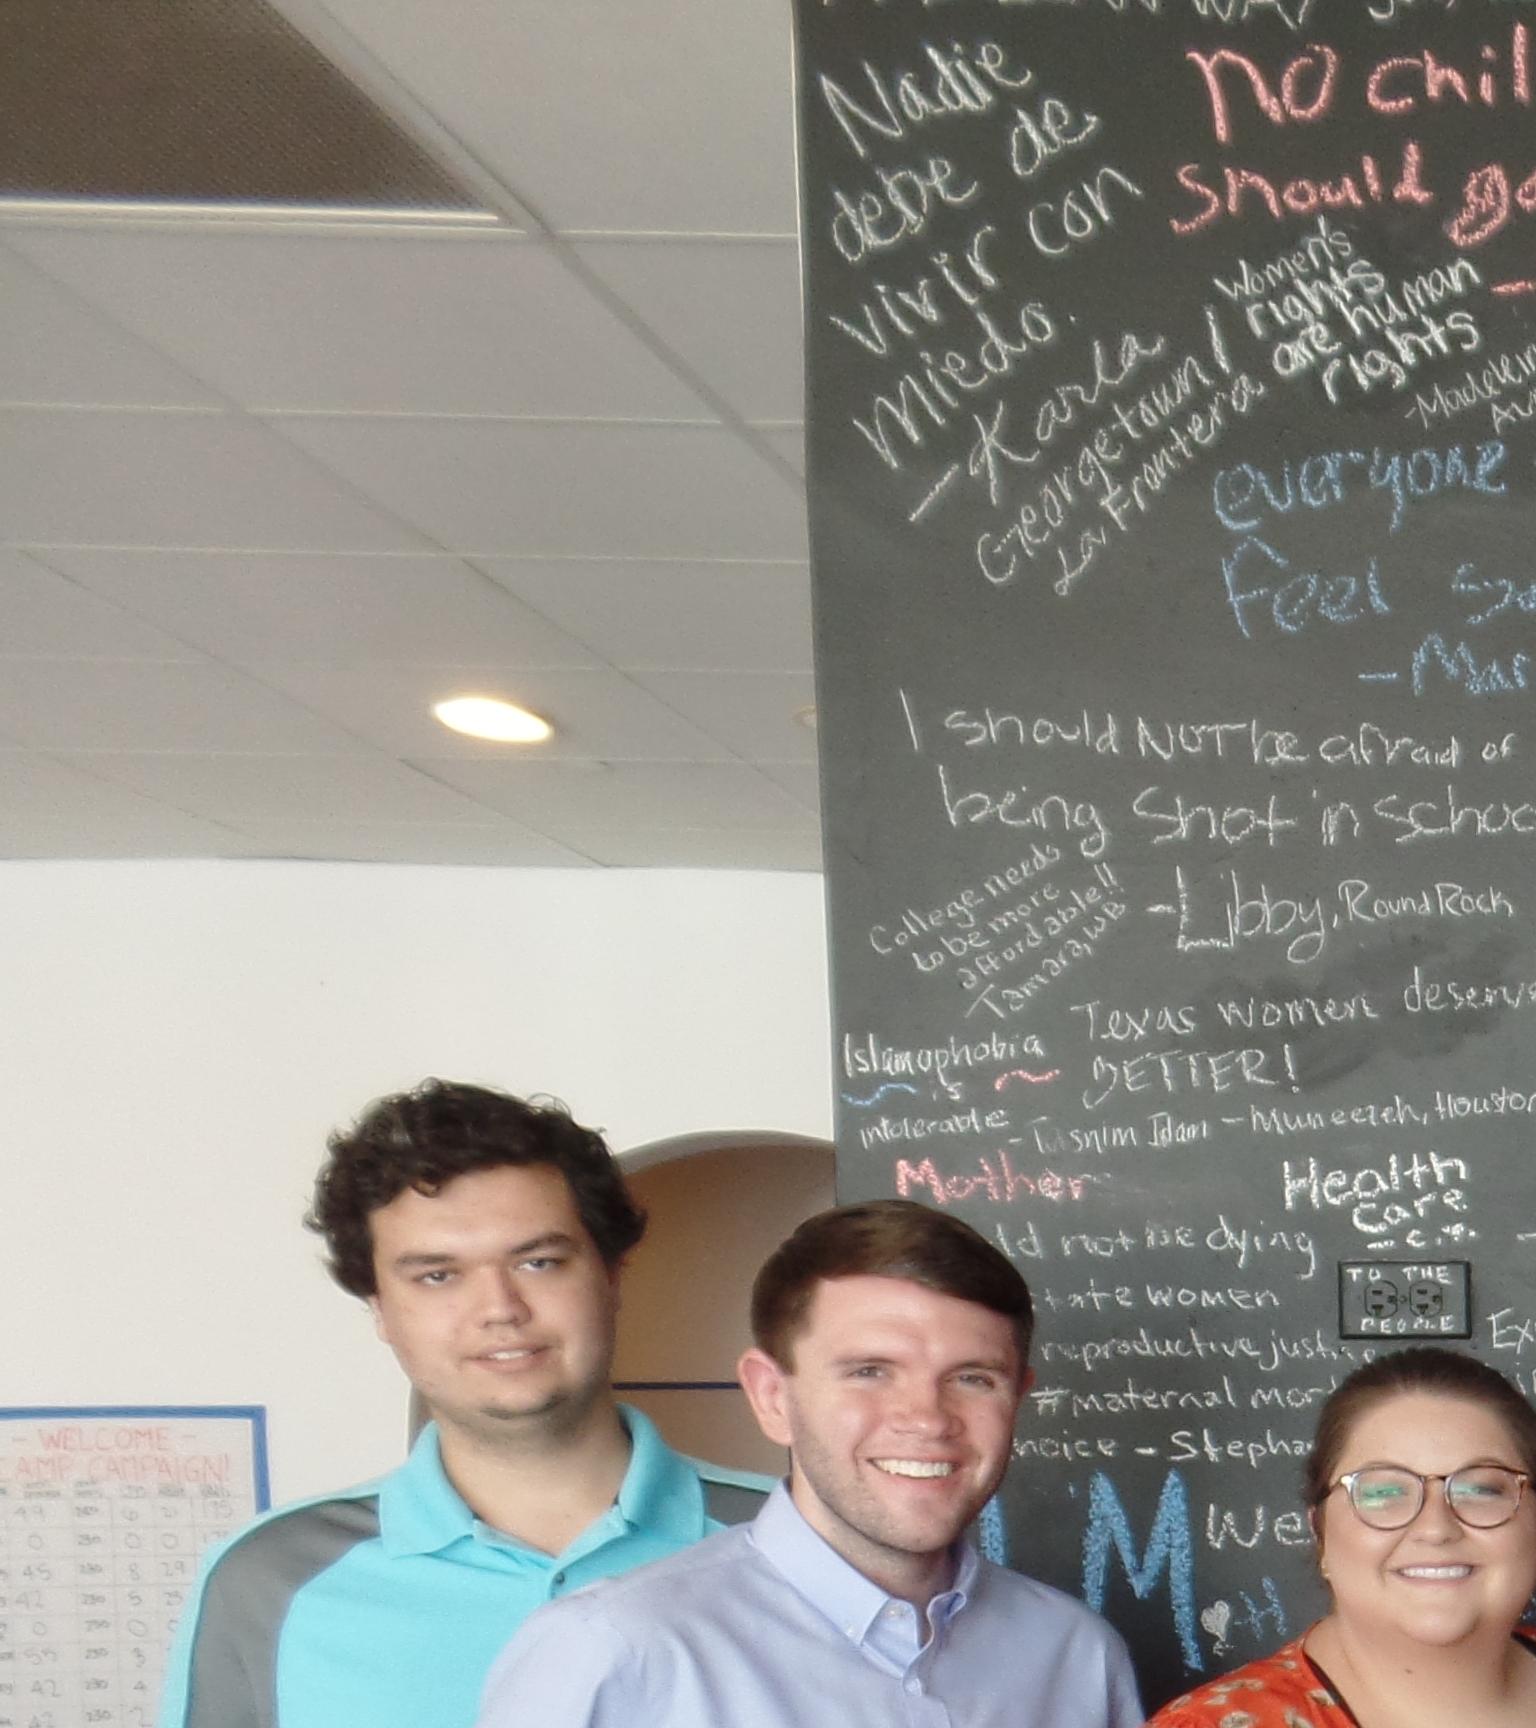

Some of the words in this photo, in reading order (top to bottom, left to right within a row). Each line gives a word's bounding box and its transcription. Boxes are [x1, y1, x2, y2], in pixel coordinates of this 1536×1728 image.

[818, 40, 1033, 157] Nadie
[1010, 97, 1099, 176] de
[1028, 167, 1143, 255] con
[1338, 257, 1481, 338] human
[1481, 732, 1517, 763] of
[1312, 789, 1359, 845] in
[1436, 882, 1515, 920] Rock
[1281, 1150, 1469, 1210] Health
[1204, 1213, 1317, 1279] dying
[1403, 1266, 1451, 1284] THE
